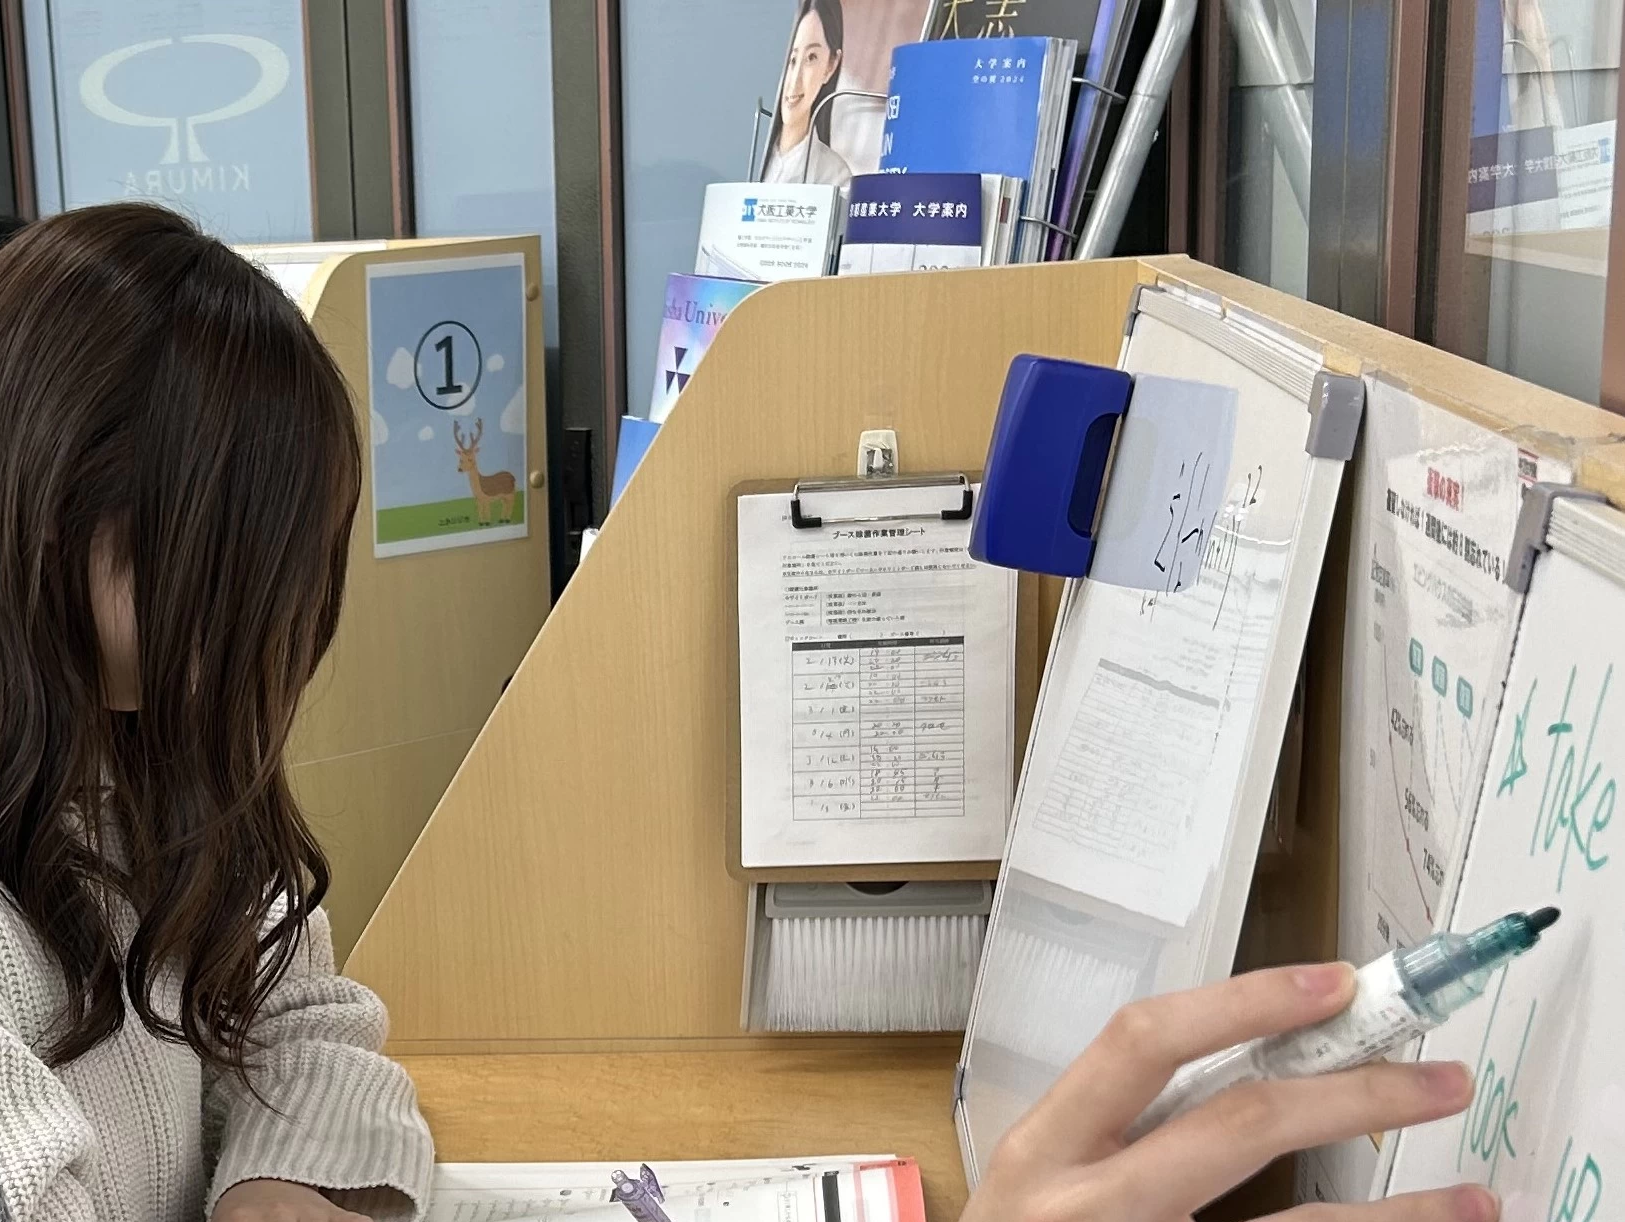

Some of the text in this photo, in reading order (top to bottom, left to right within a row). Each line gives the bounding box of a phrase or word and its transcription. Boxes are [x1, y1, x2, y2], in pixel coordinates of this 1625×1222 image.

[758, 204, 817, 218] 大阪工業大学
[912, 202, 968, 219] 大学案内
[1457, 963, 1537, 1189] look
